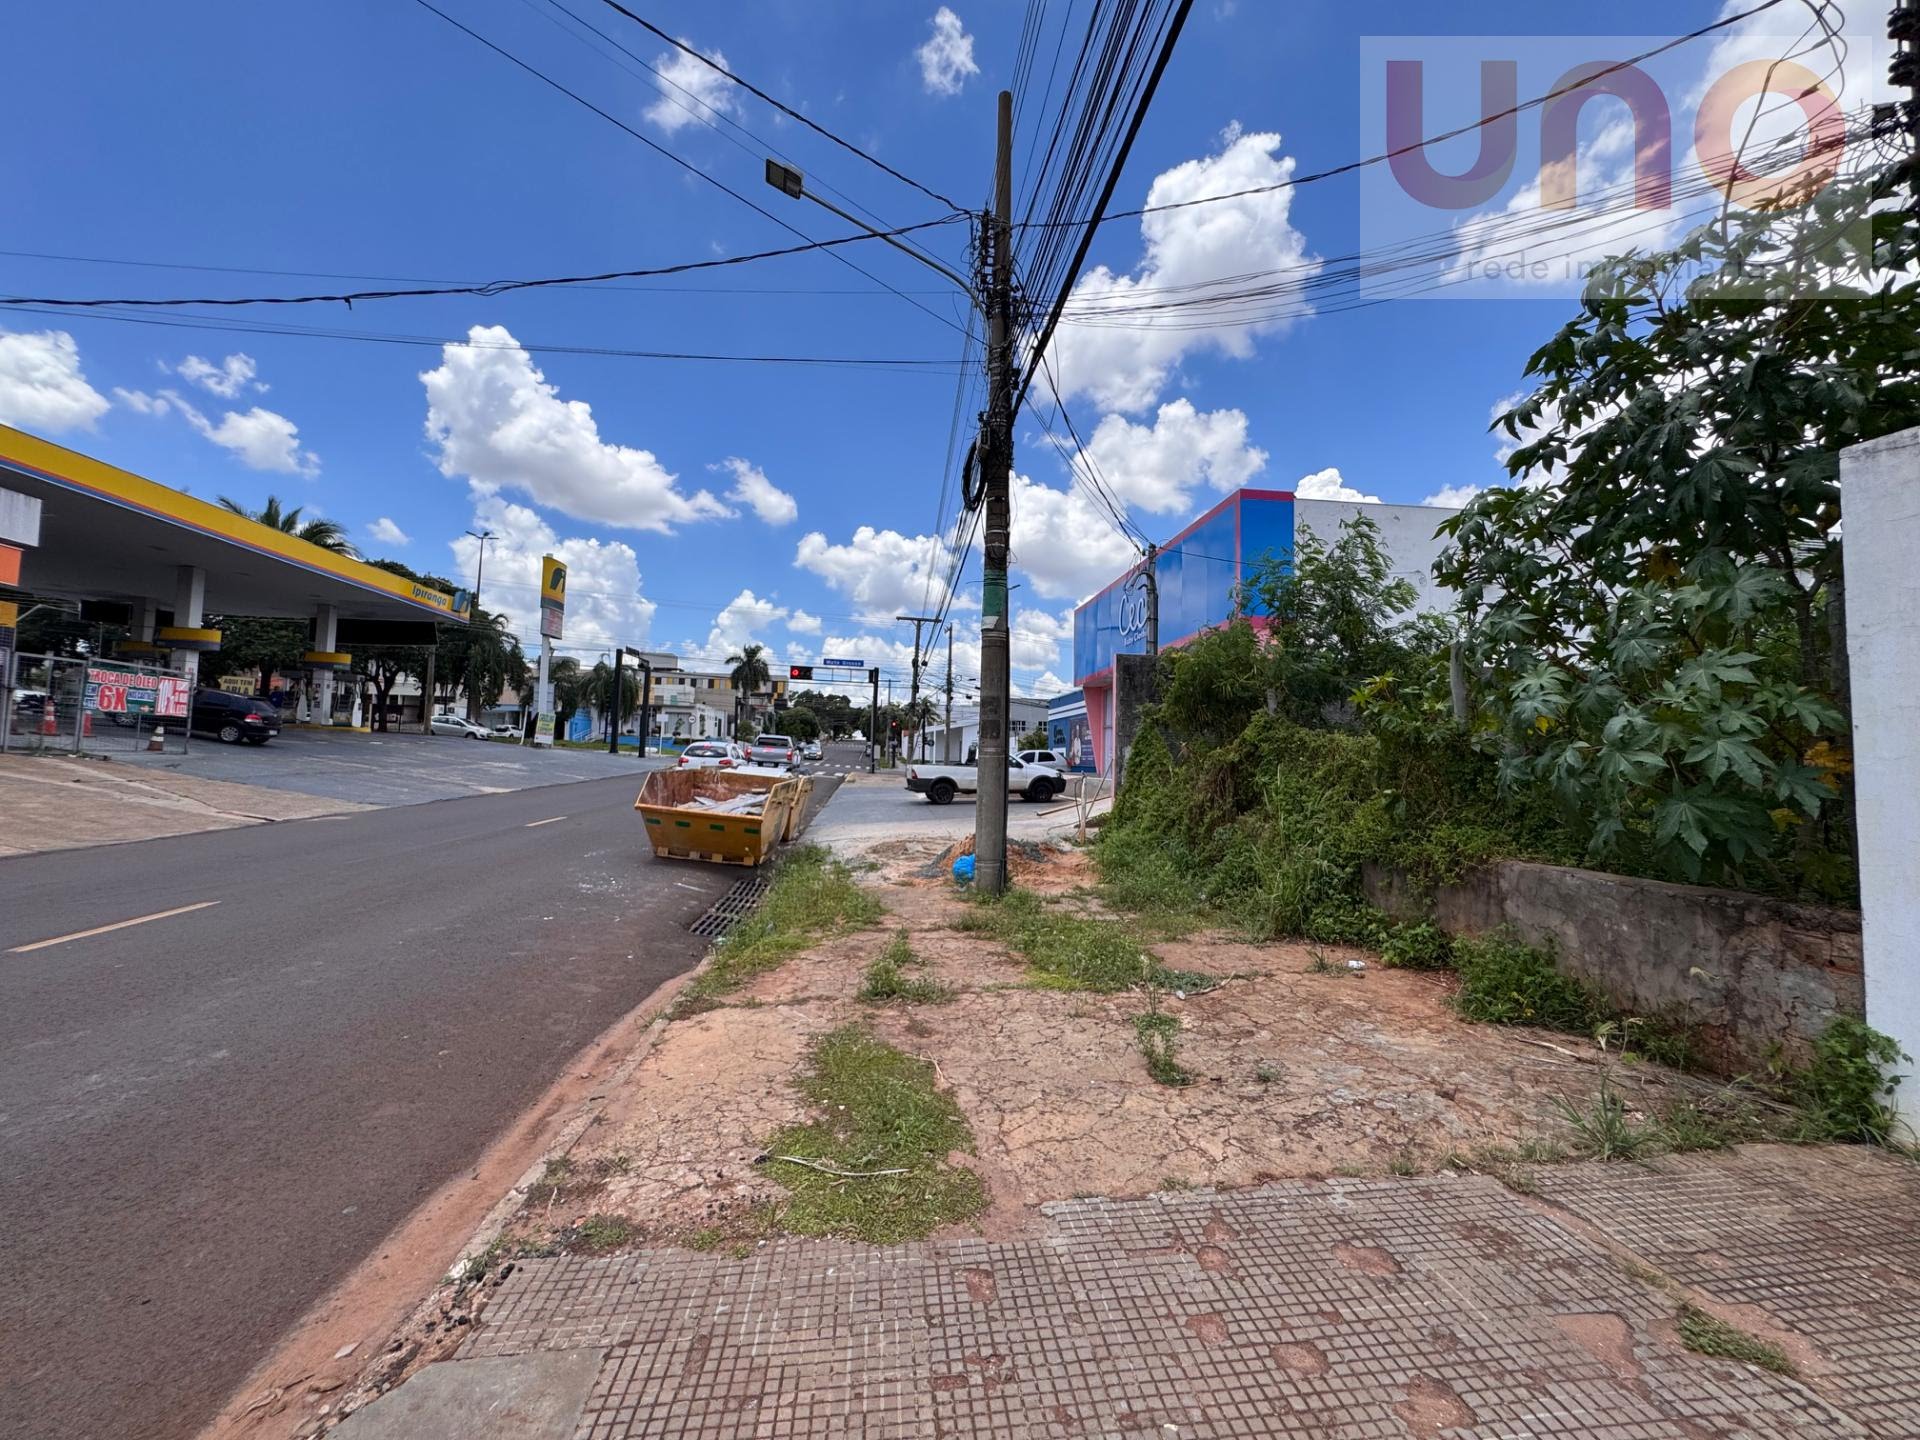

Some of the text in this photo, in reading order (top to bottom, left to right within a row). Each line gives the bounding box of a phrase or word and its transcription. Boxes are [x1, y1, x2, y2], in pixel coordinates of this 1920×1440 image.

[412, 585, 447, 606] Ipiranga
[1119, 594, 1148, 636] Cec
[89, 669, 157, 689] TROCA DE ÓLEO
[98, 685, 128, 712] 6X
